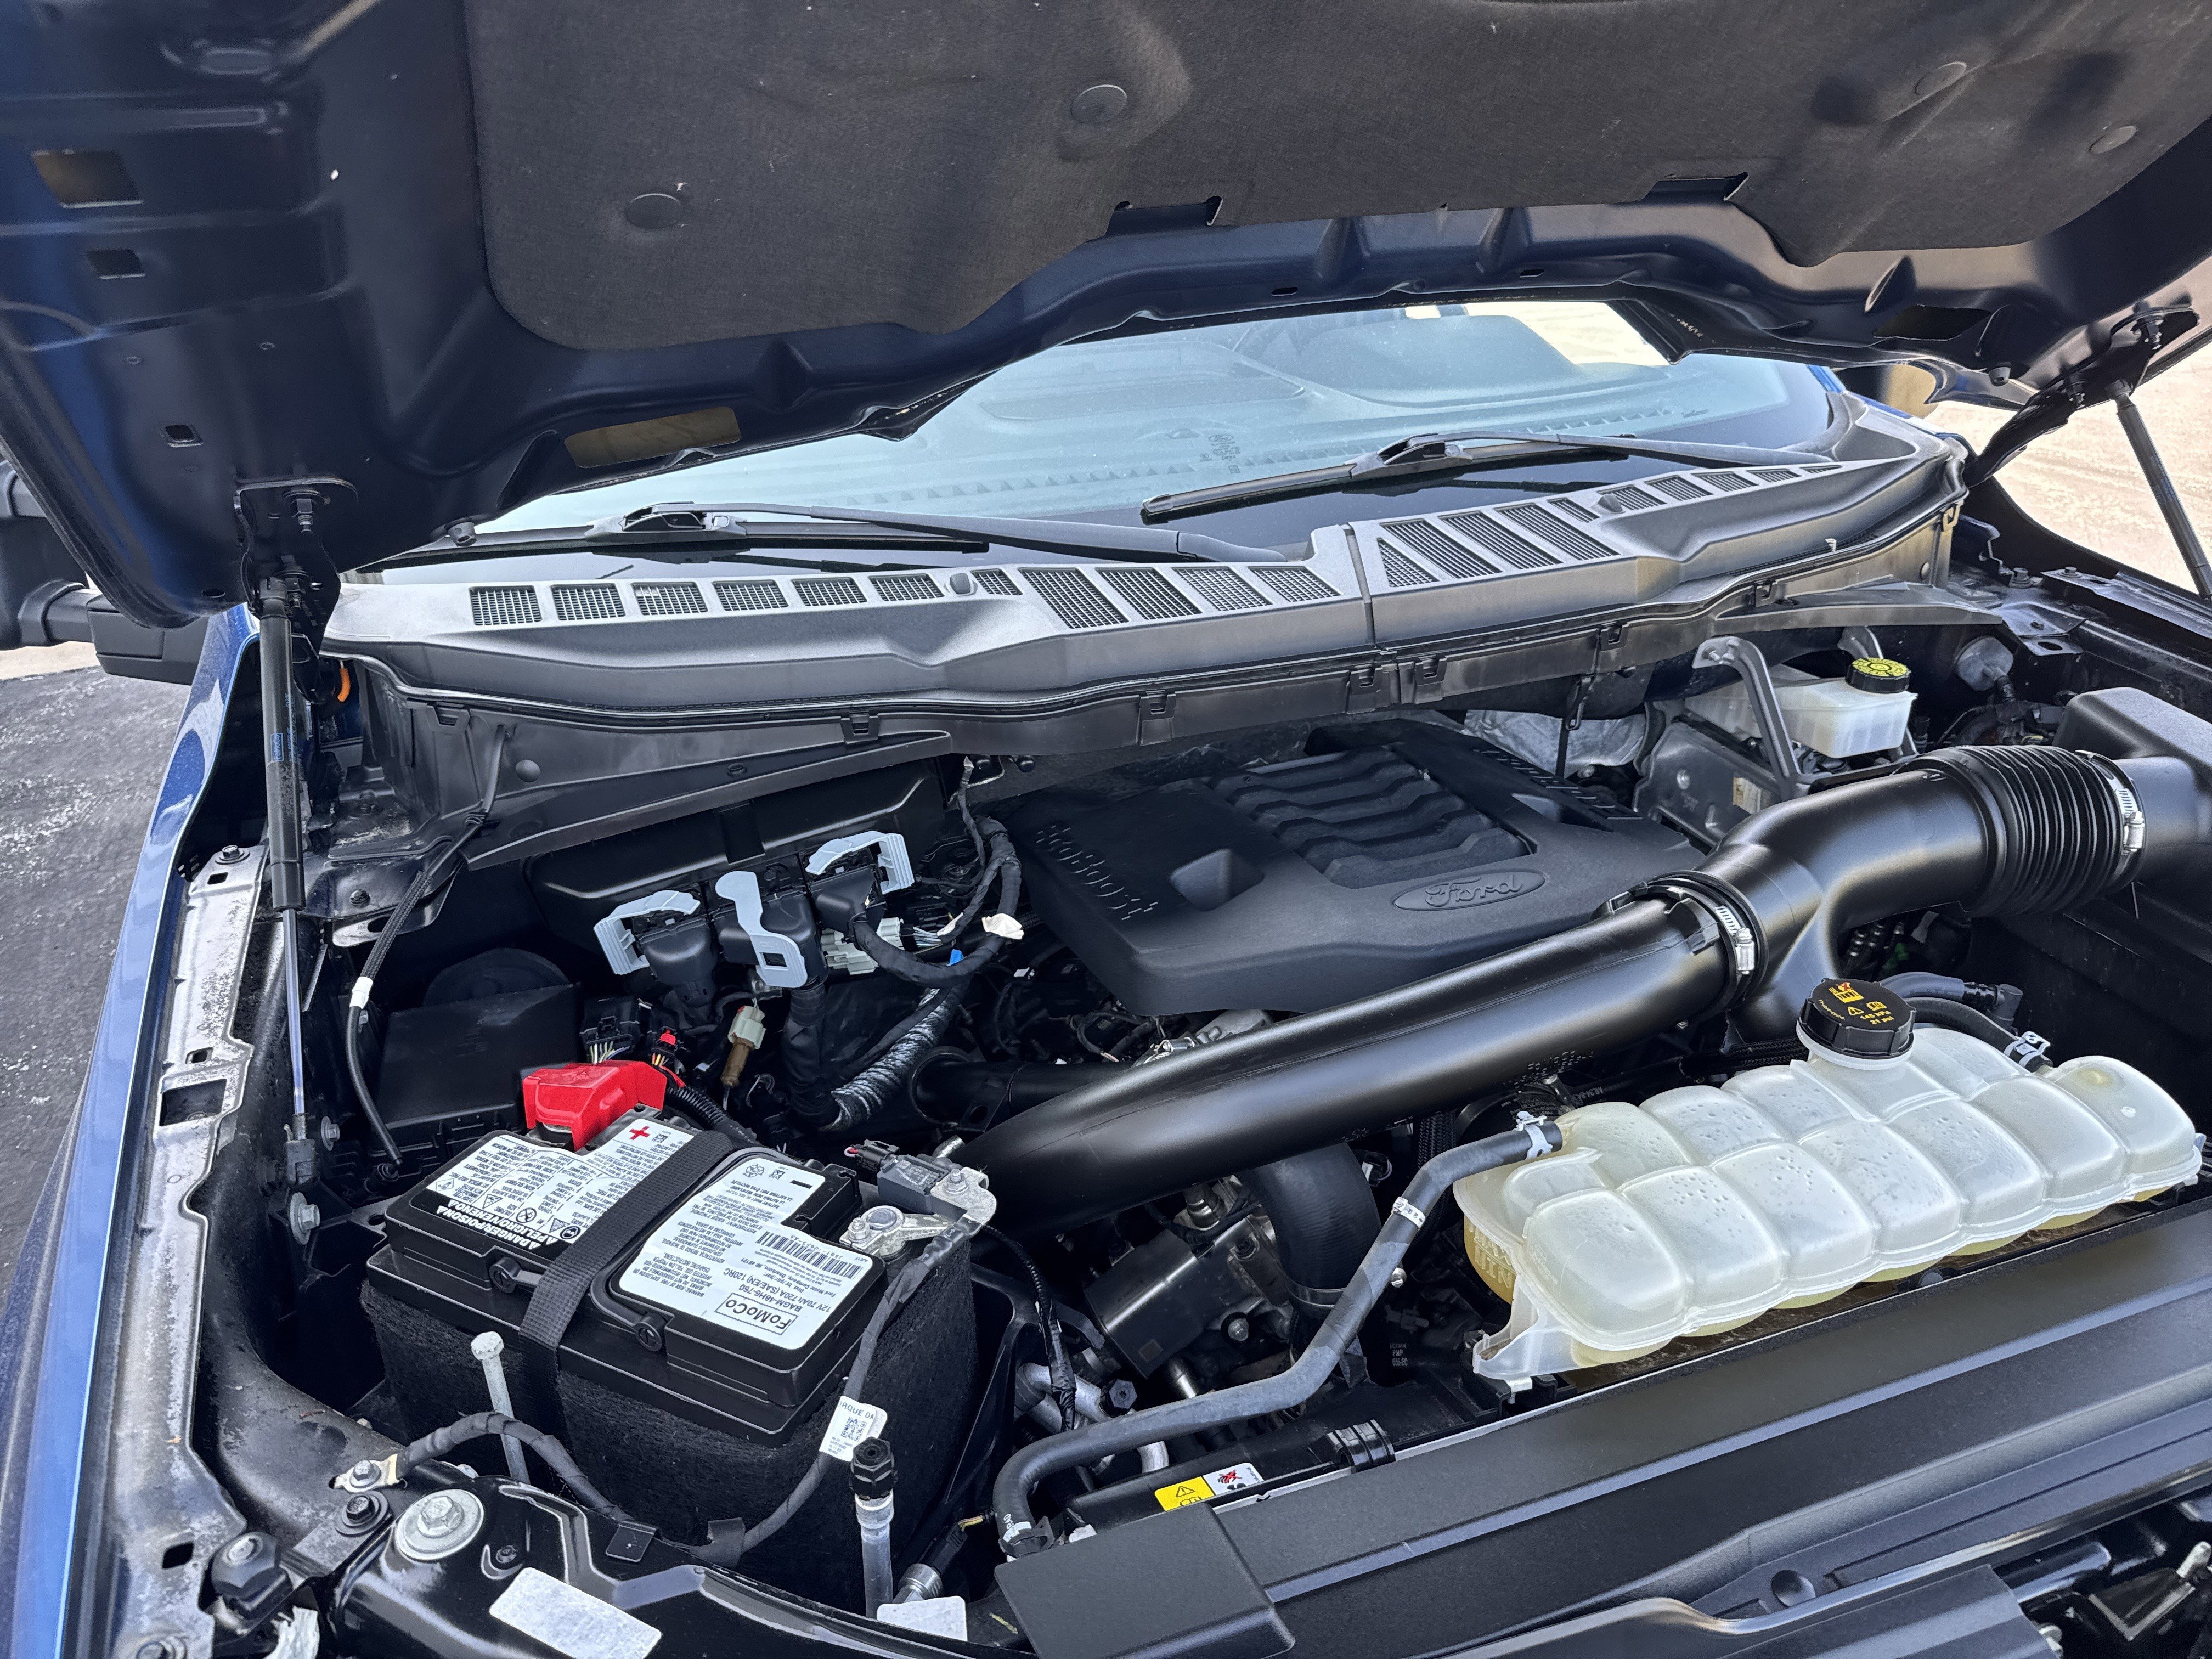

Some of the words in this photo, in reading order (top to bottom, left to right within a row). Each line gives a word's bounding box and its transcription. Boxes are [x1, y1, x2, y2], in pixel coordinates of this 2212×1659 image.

[1424, 874, 1523, 907] Ford
[443, 1209, 531, 1246] DANGER/POISON
[455, 1203, 548, 1242] PELIGRO/VENENO
[639, 1271, 661, 1281] EXPLOSION
[724, 1268, 746, 1280] 120RC
[764, 1265, 786, 1278] Dearborn,
[1475, 1245, 1513, 1289] MIN
[747, 1276, 780, 1294] (SAE/EN)
[788, 1276, 810, 1289] Company,
[739, 1284, 803, 1312] BAGM-48H6-760
[780, 1290, 798, 1301] 720A
[798, 1297, 817, 1307] 70Ah
[726, 1300, 792, 1329] FoMoCo
